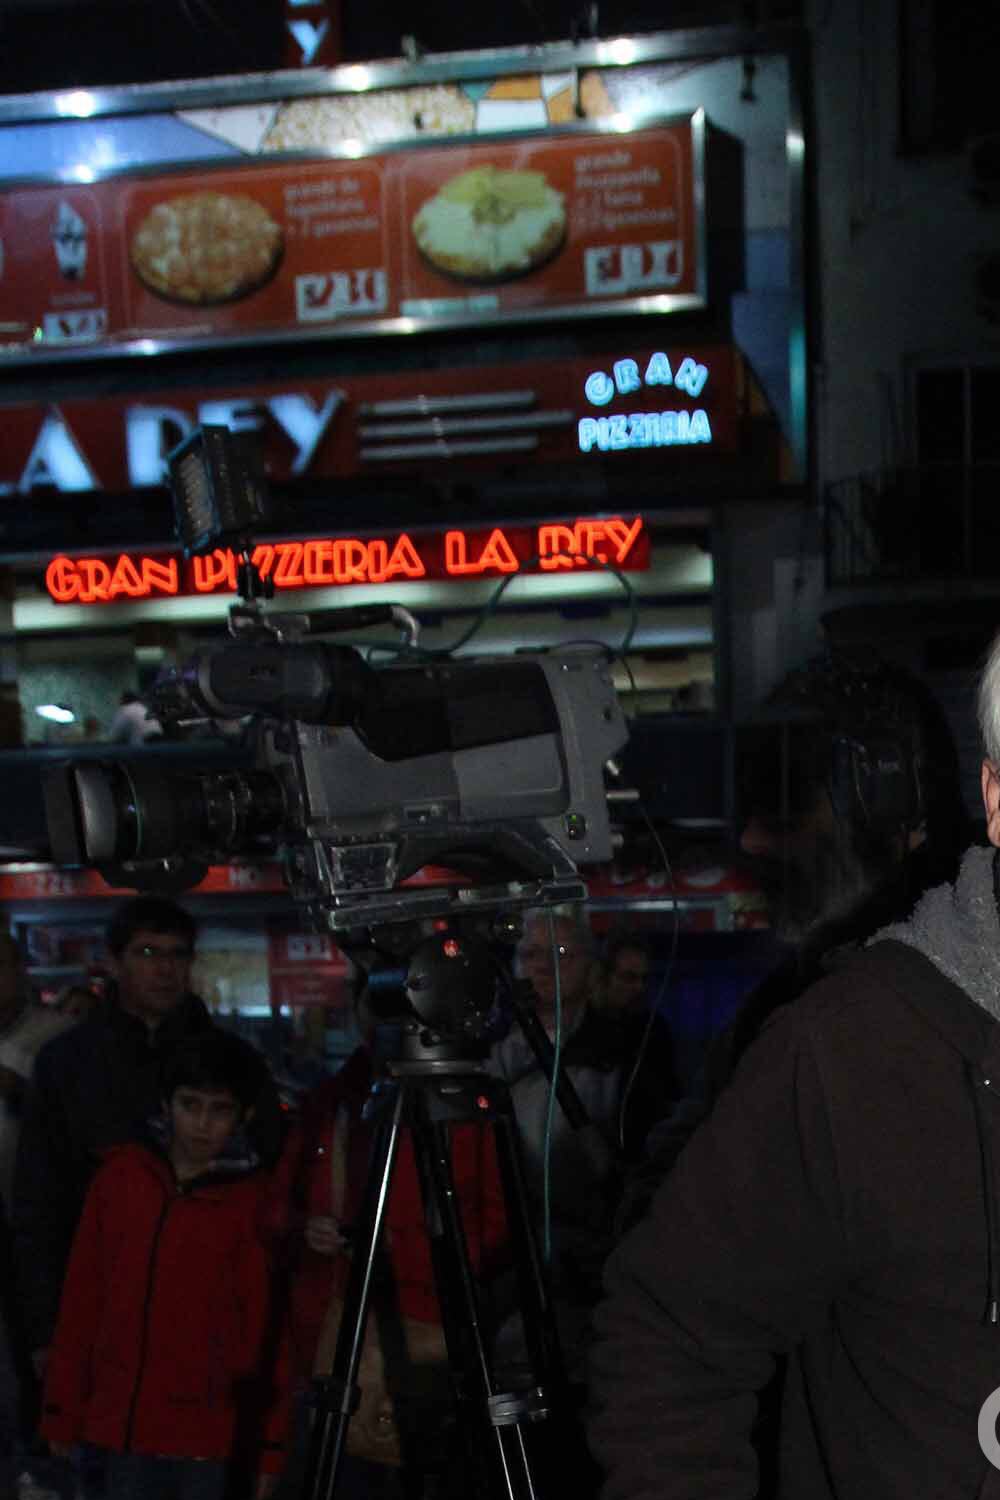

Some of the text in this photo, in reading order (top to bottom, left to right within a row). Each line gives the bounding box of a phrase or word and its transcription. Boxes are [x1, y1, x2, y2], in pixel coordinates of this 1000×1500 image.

[584, 352, 709, 407] GRAN
[0, 403, 99, 494] A
[46, 553, 178, 602] GRAN
[446, 528, 519, 574] LA
[539, 514, 643, 570] REY
